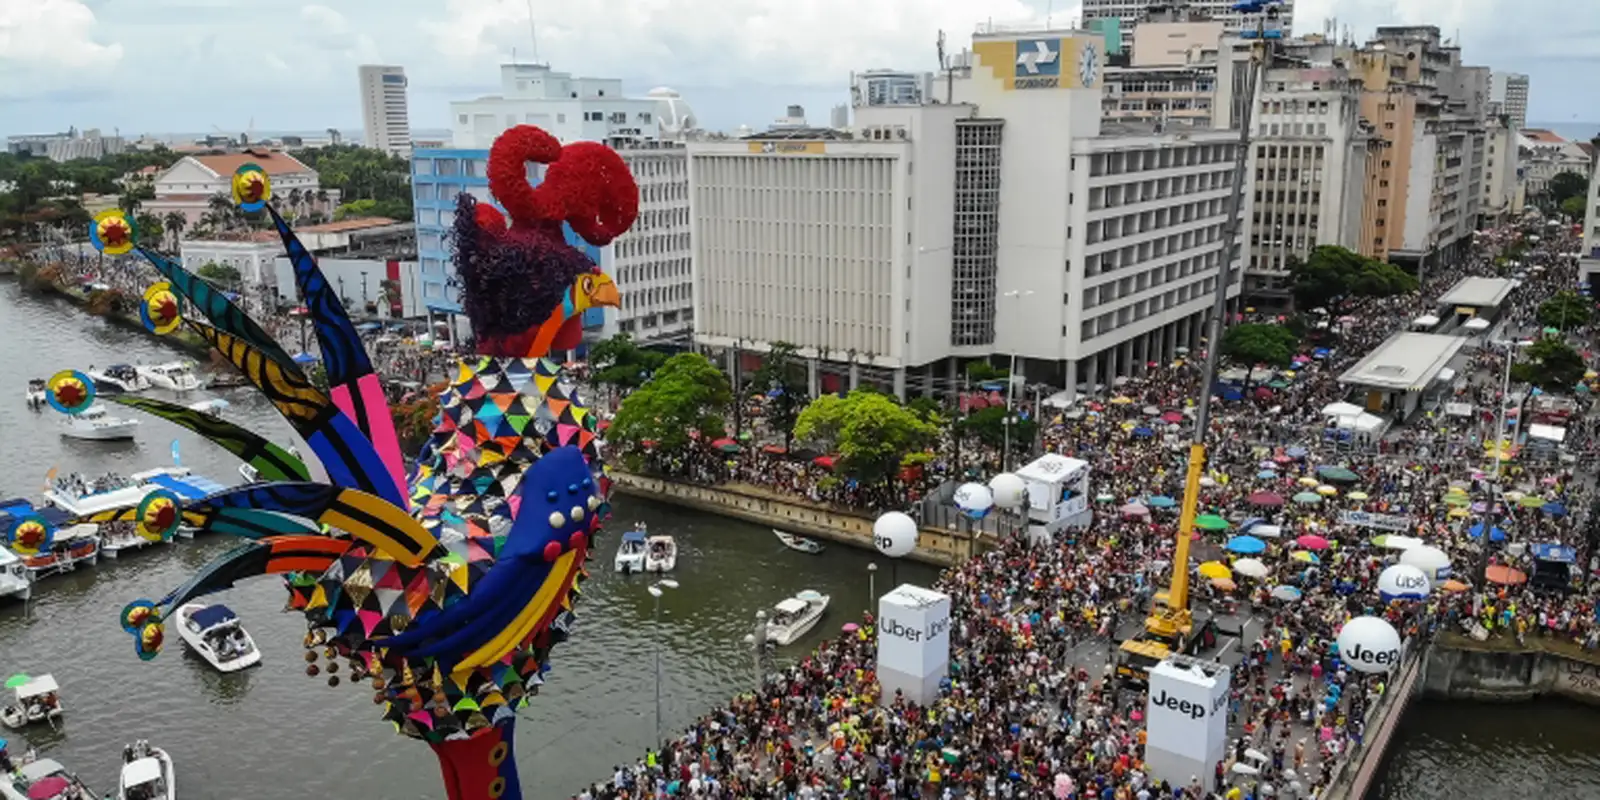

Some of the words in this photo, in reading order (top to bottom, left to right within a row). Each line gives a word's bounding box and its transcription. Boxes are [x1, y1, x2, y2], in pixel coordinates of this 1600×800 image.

[881, 616, 923, 642] Uber
[1346, 643, 1399, 665] Jeep
[1152, 689, 1206, 720] Jeep
